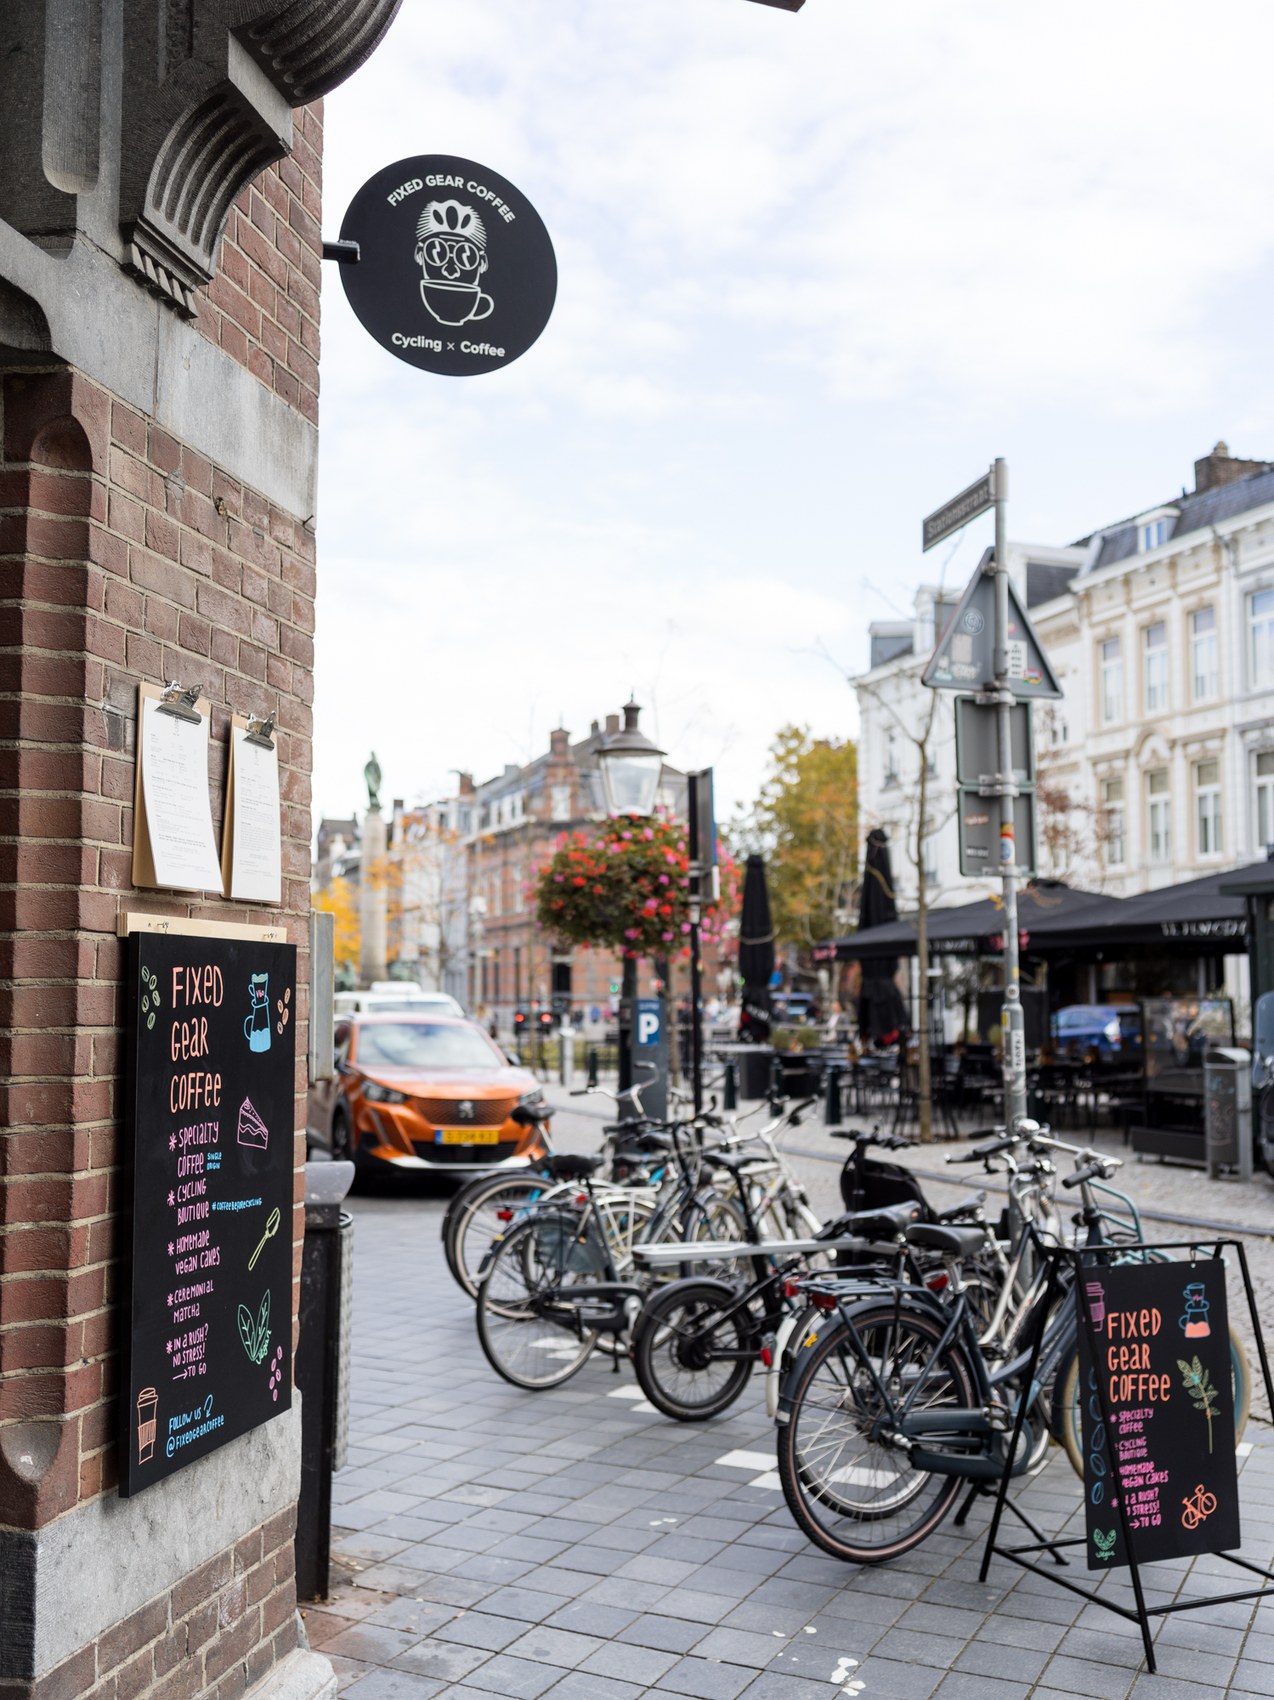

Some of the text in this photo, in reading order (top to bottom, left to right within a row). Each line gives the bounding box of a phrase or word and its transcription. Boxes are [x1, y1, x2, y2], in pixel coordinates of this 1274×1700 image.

[387, 174, 516, 223] FIXED GEAR COFFEE
[391, 332, 442, 352] Cycling
[460, 340, 506, 357] Coffee
[639, 1012, 660, 1044] P
[172, 1352, 181, 1367] NO
[187, 1362, 207, 1377] TO GO
[168, 1407, 202, 1435] FOLLOW US
[1139, 1513, 1162, 1528] TO GO
